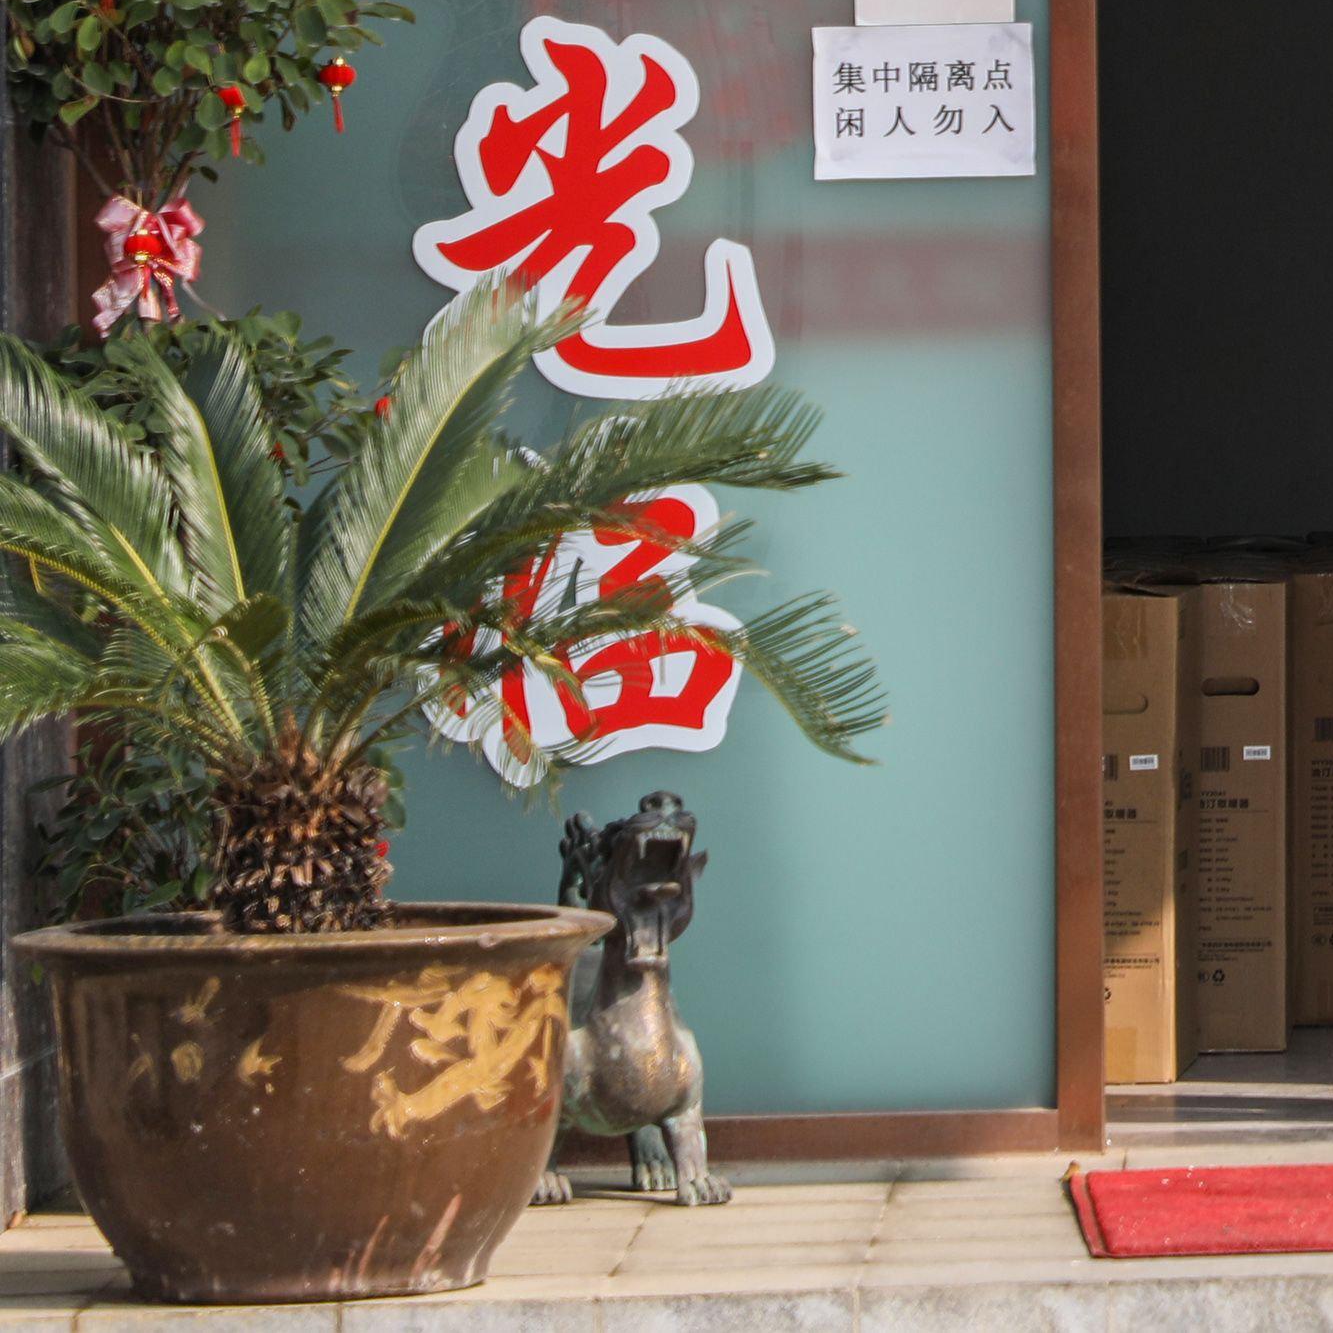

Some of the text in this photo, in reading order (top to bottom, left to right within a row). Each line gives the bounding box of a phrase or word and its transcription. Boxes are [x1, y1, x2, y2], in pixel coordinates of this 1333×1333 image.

[832, 59, 1014, 95] 集中隔离点
[835, 104, 1015, 139] 闲人勿入
